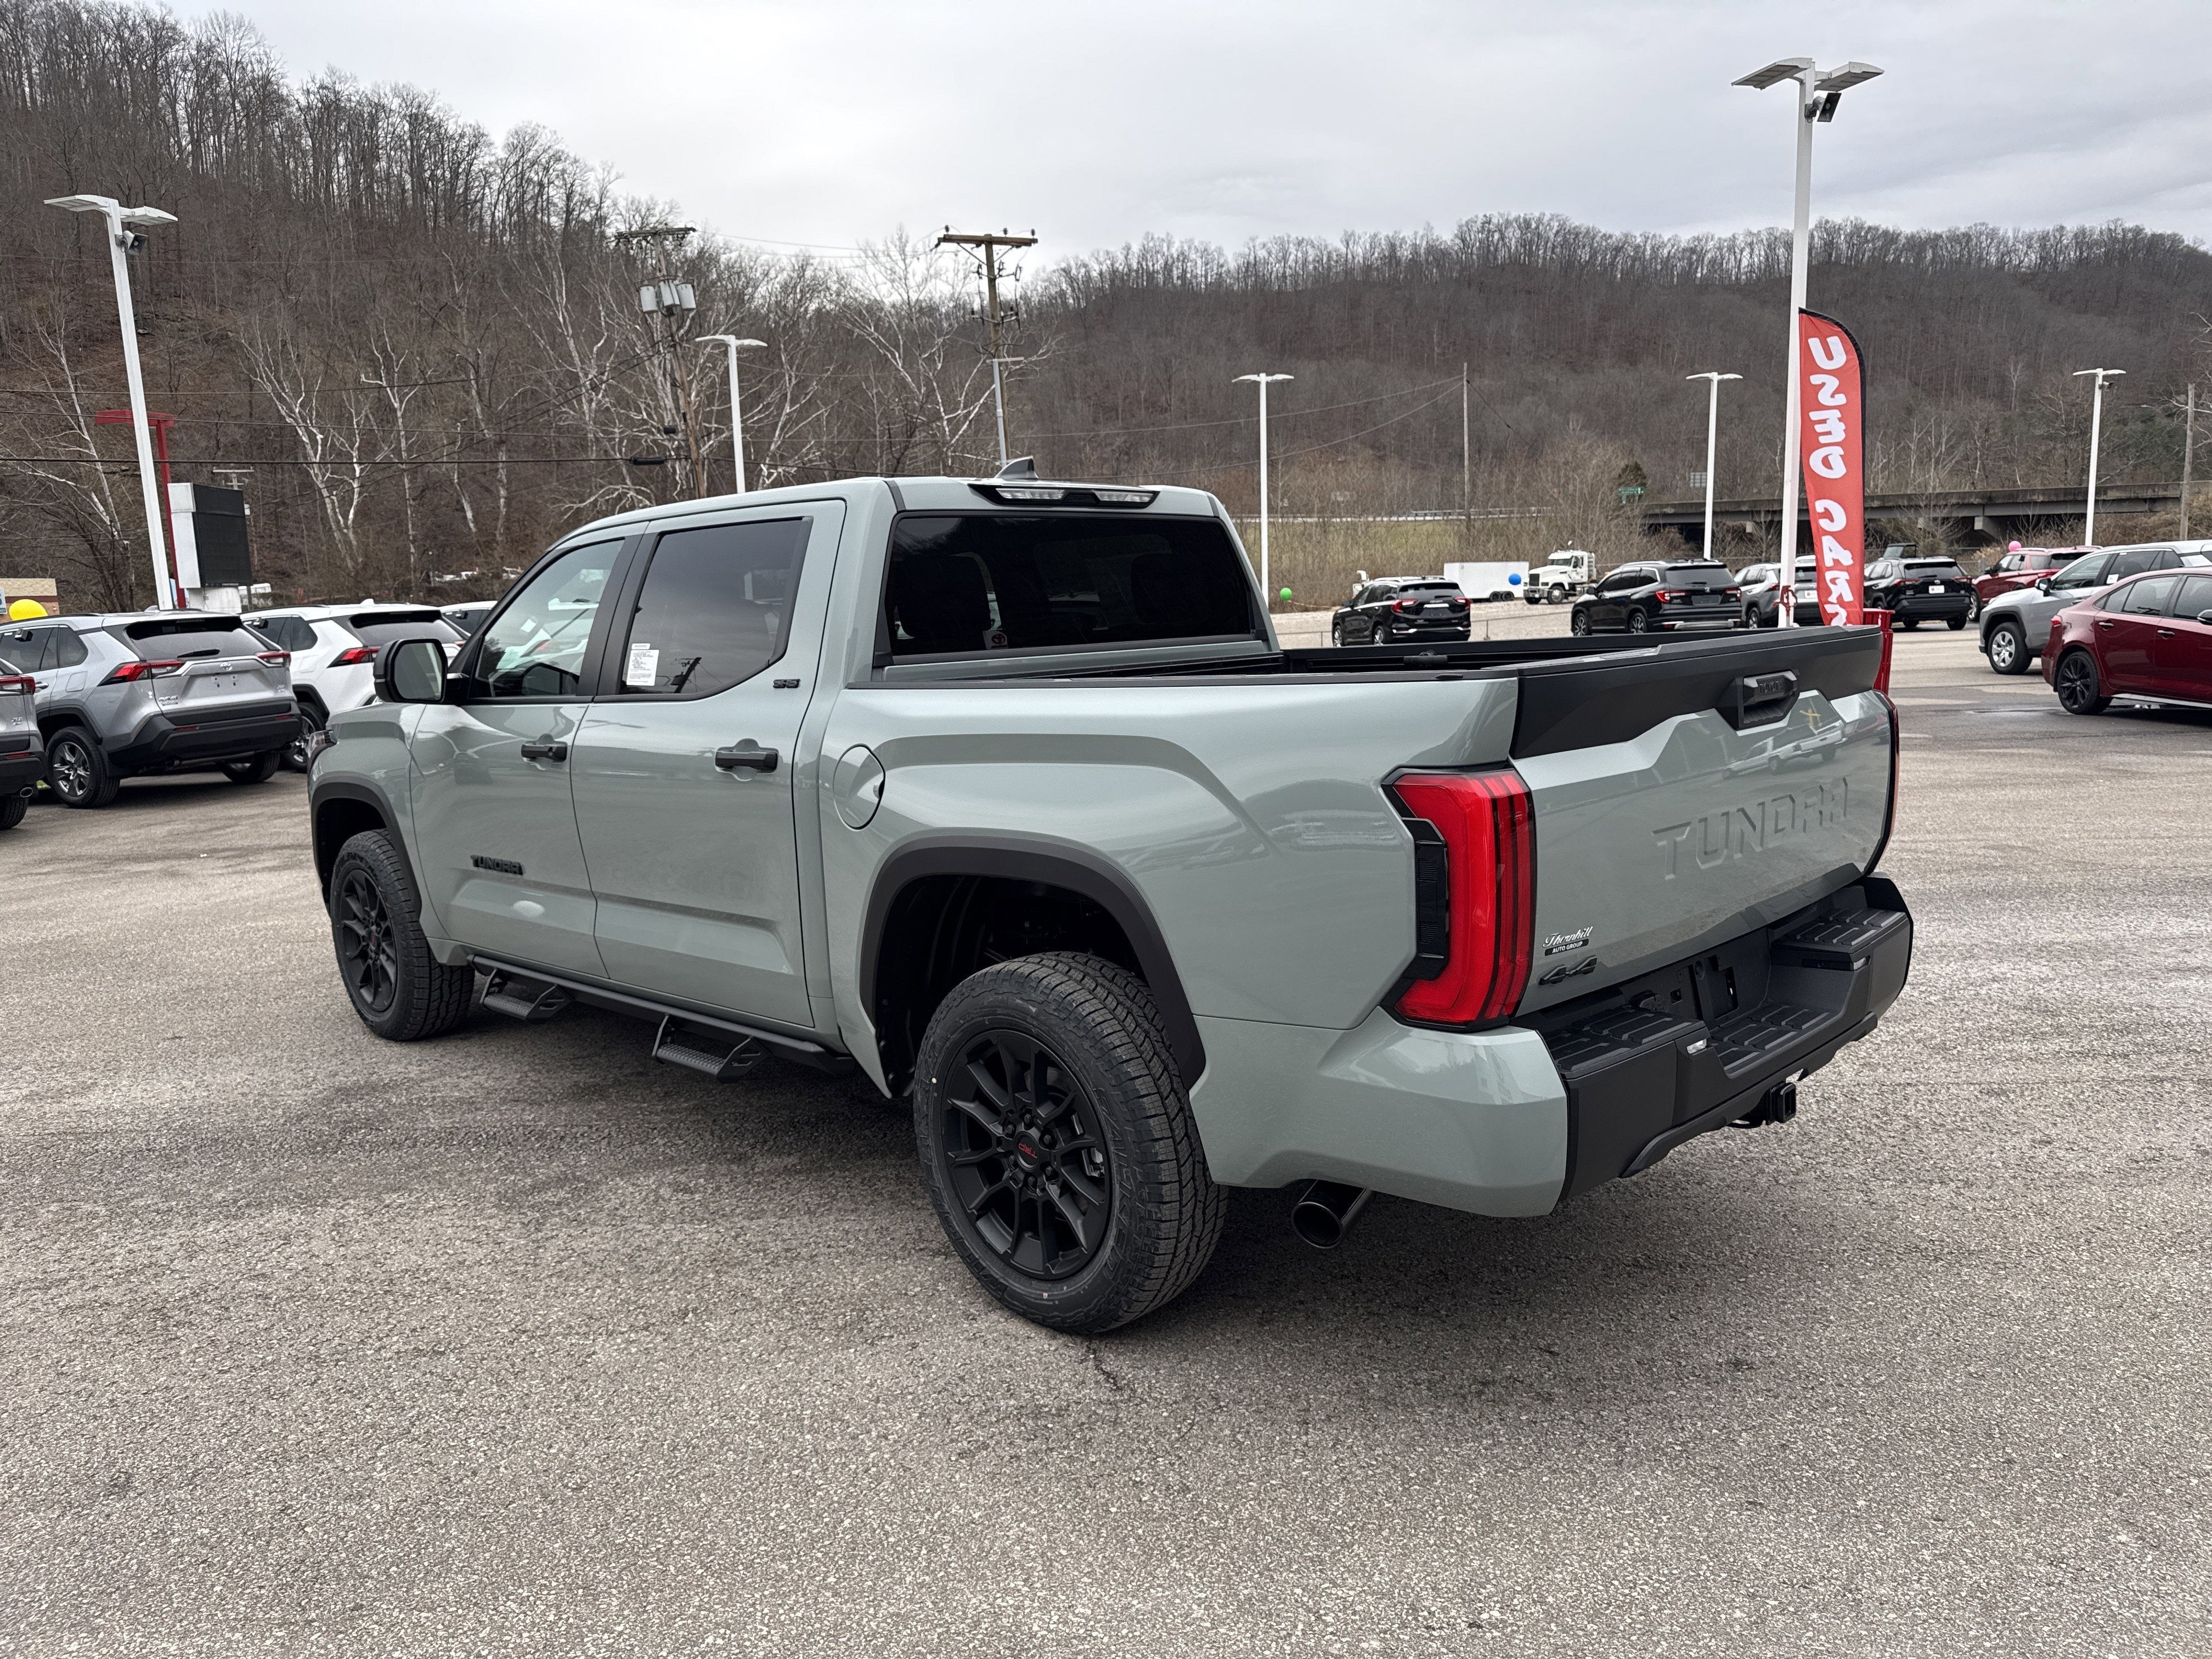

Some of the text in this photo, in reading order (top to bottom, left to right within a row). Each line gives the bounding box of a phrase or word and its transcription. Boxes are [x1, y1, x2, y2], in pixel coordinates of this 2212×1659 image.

[1651, 776, 1849, 881] TUNDRA
[470, 854, 524, 875] TUNDRA
[1542, 926, 1594, 948] Thornhill
[1551, 941, 1583, 954] AUTO GROUP
